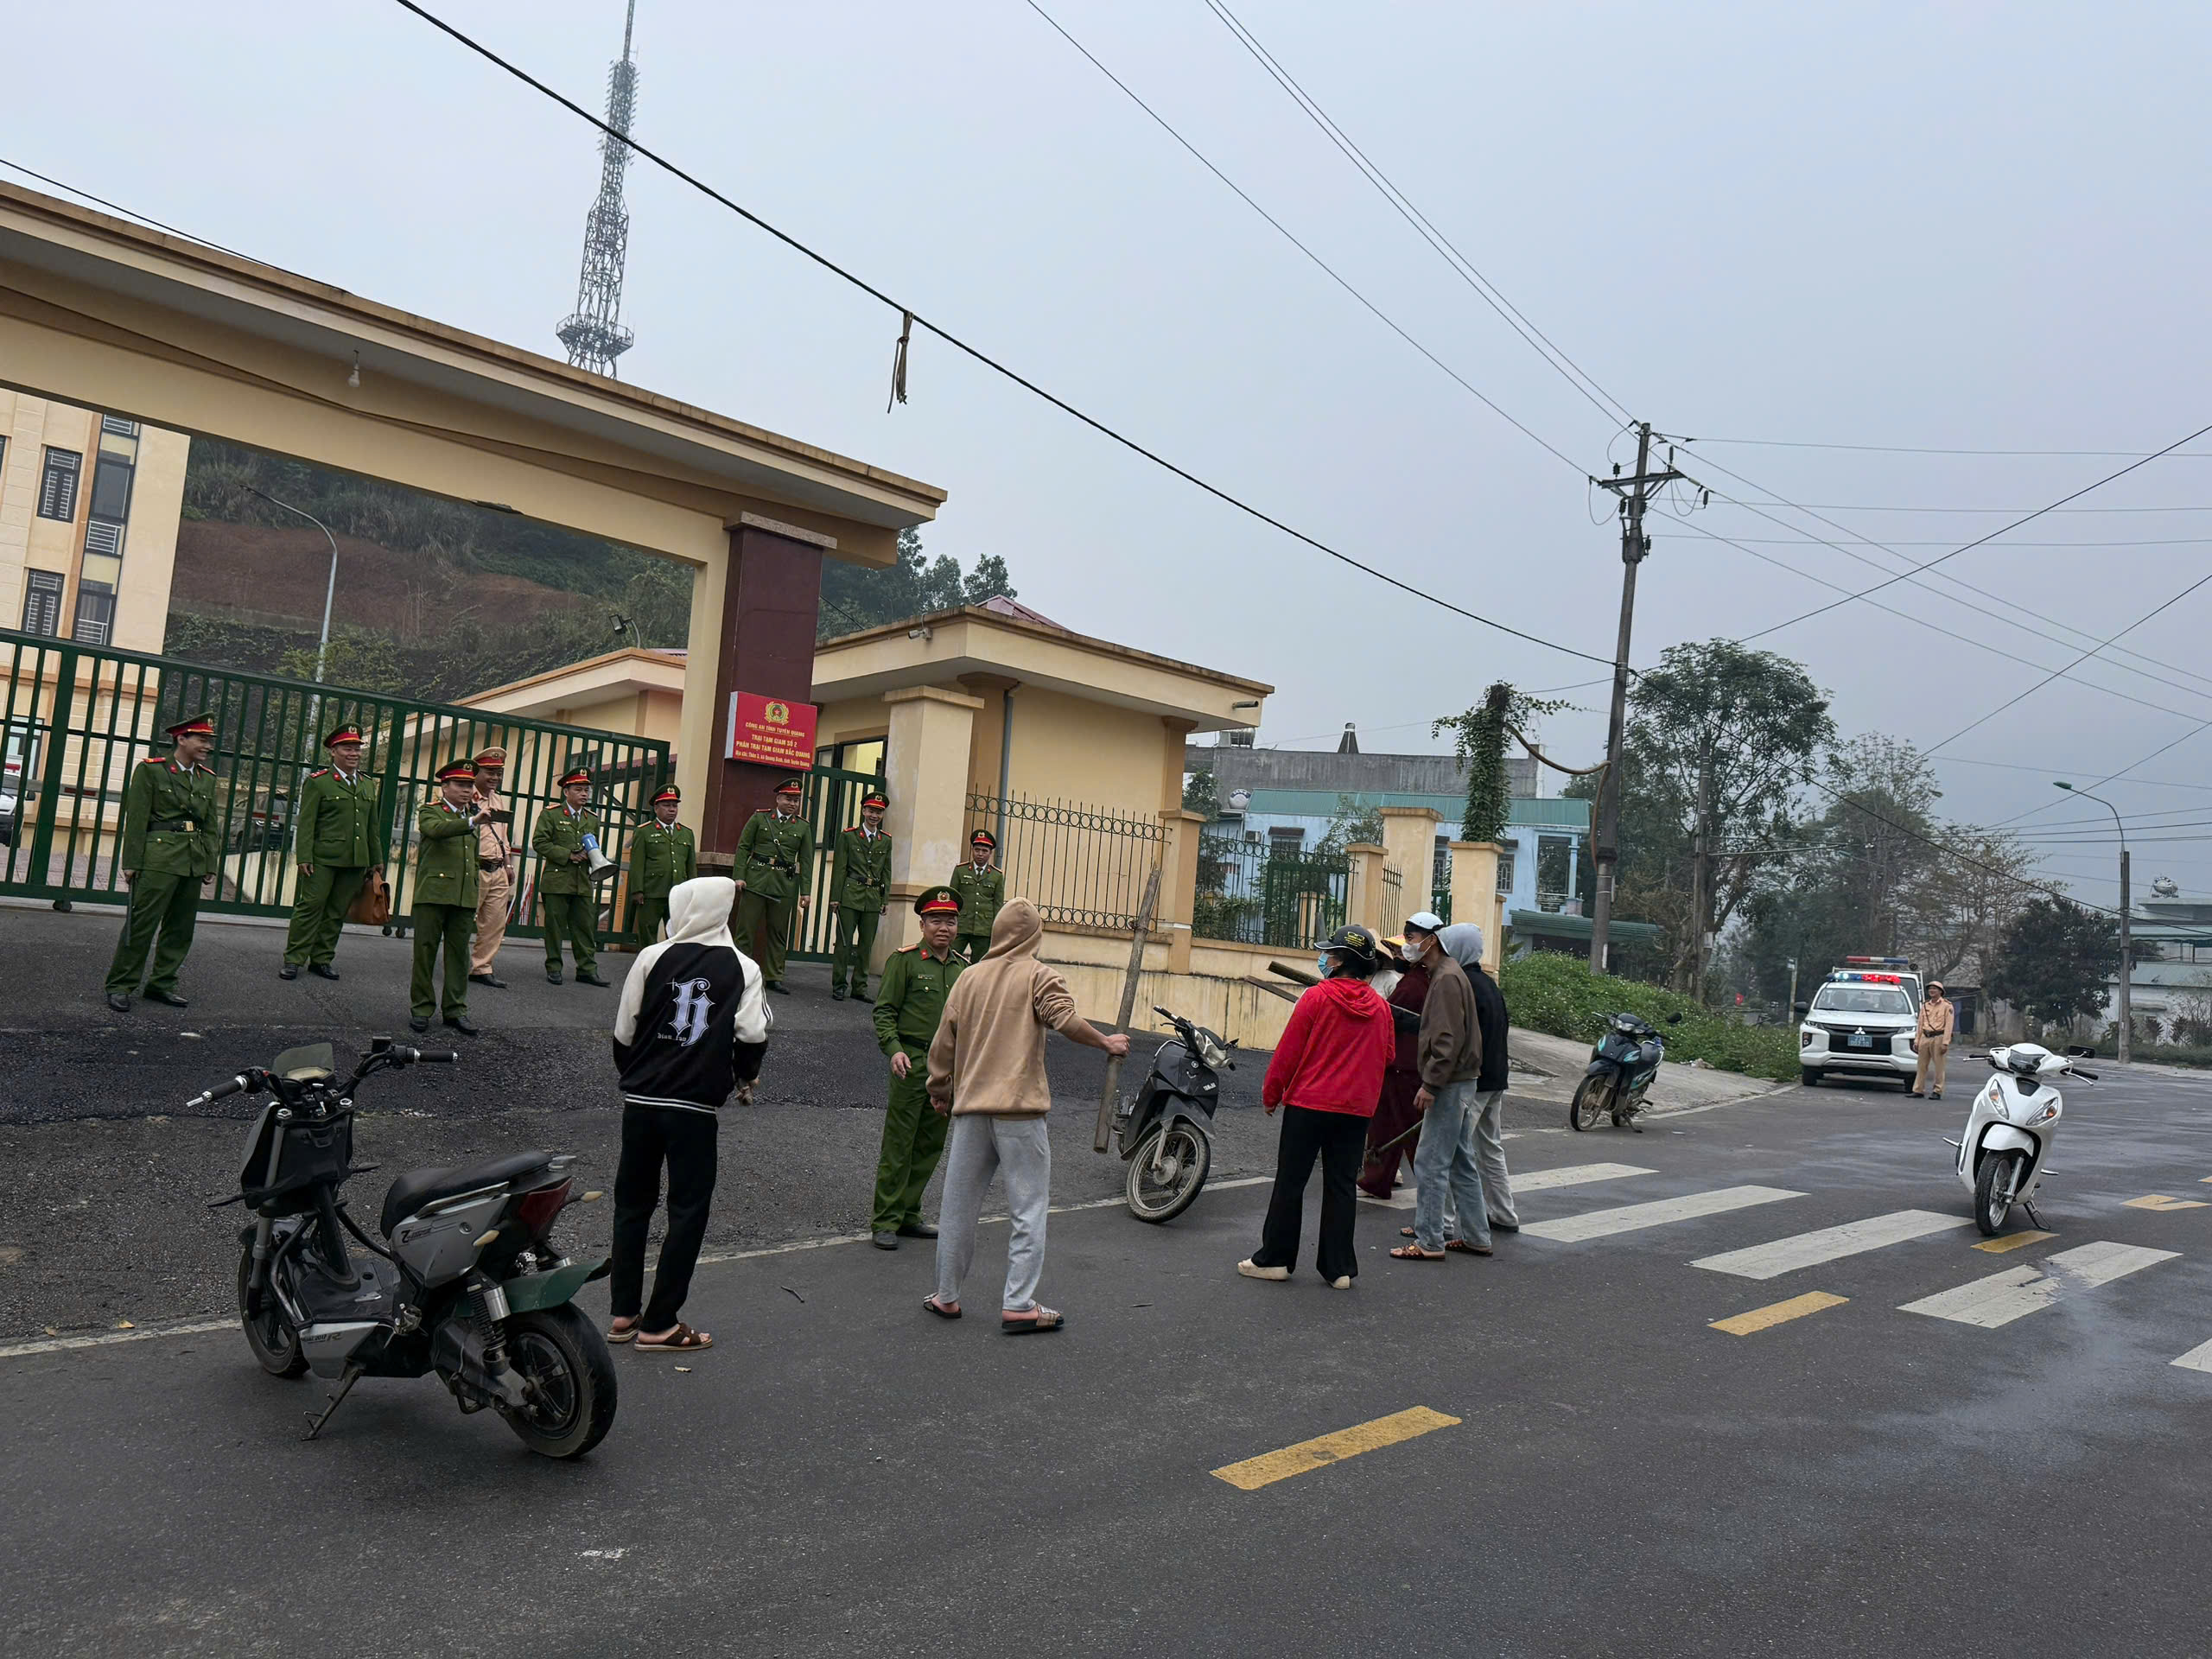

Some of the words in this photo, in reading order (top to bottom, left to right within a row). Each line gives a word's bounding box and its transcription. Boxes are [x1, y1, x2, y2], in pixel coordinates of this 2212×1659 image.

[791, 729, 805, 738] QUANG
[752, 734, 762, 742] TRẠI
[786, 739, 793, 747] SỐ
[750, 743, 761, 752] TRẠI
[785, 747, 795, 756] BẮC
[795, 750, 810, 759] QUANG
